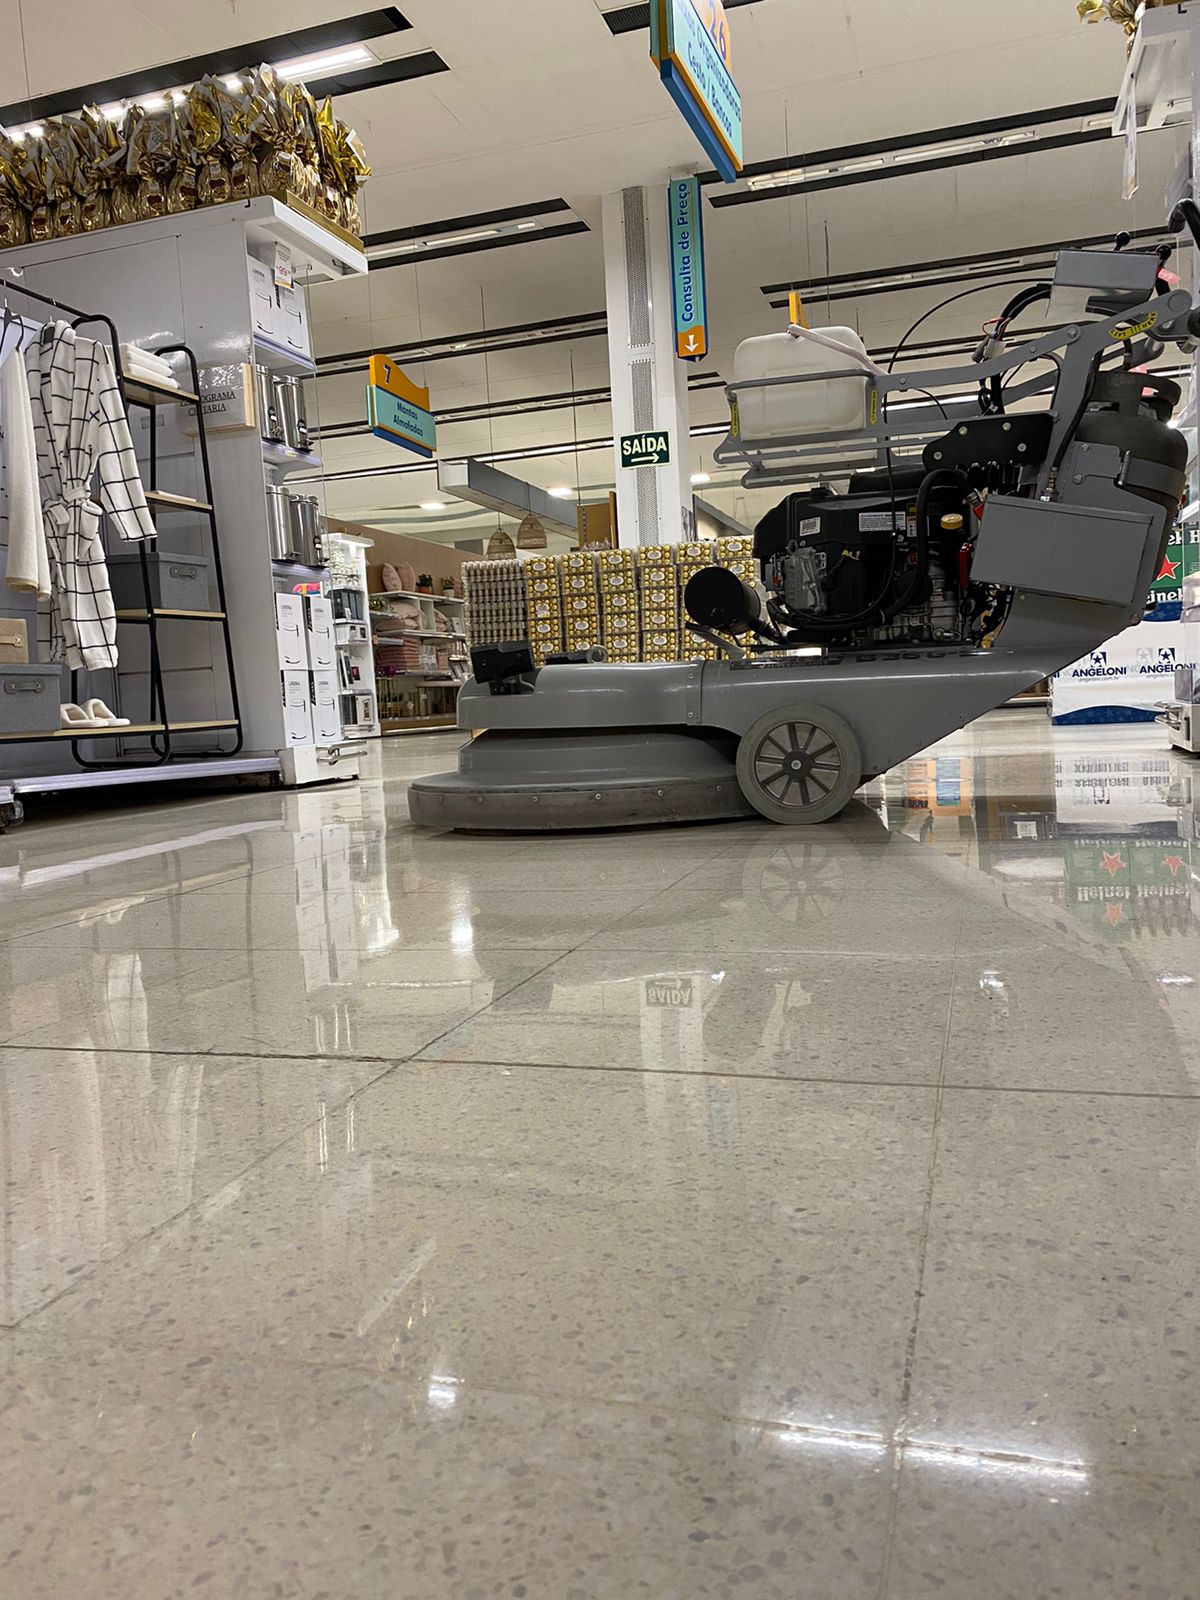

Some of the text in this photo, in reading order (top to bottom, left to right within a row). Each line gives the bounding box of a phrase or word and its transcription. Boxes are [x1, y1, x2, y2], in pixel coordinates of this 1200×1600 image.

[677, 183, 693, 322] Consulta de Preço
[384, 364, 391, 384] 7
[396, 401, 418, 420] Mantas
[393, 414, 423, 436] Almofadas
[622, 434, 667, 455] SAÍDA
[1072, 667, 1127, 677] ANGELONI
